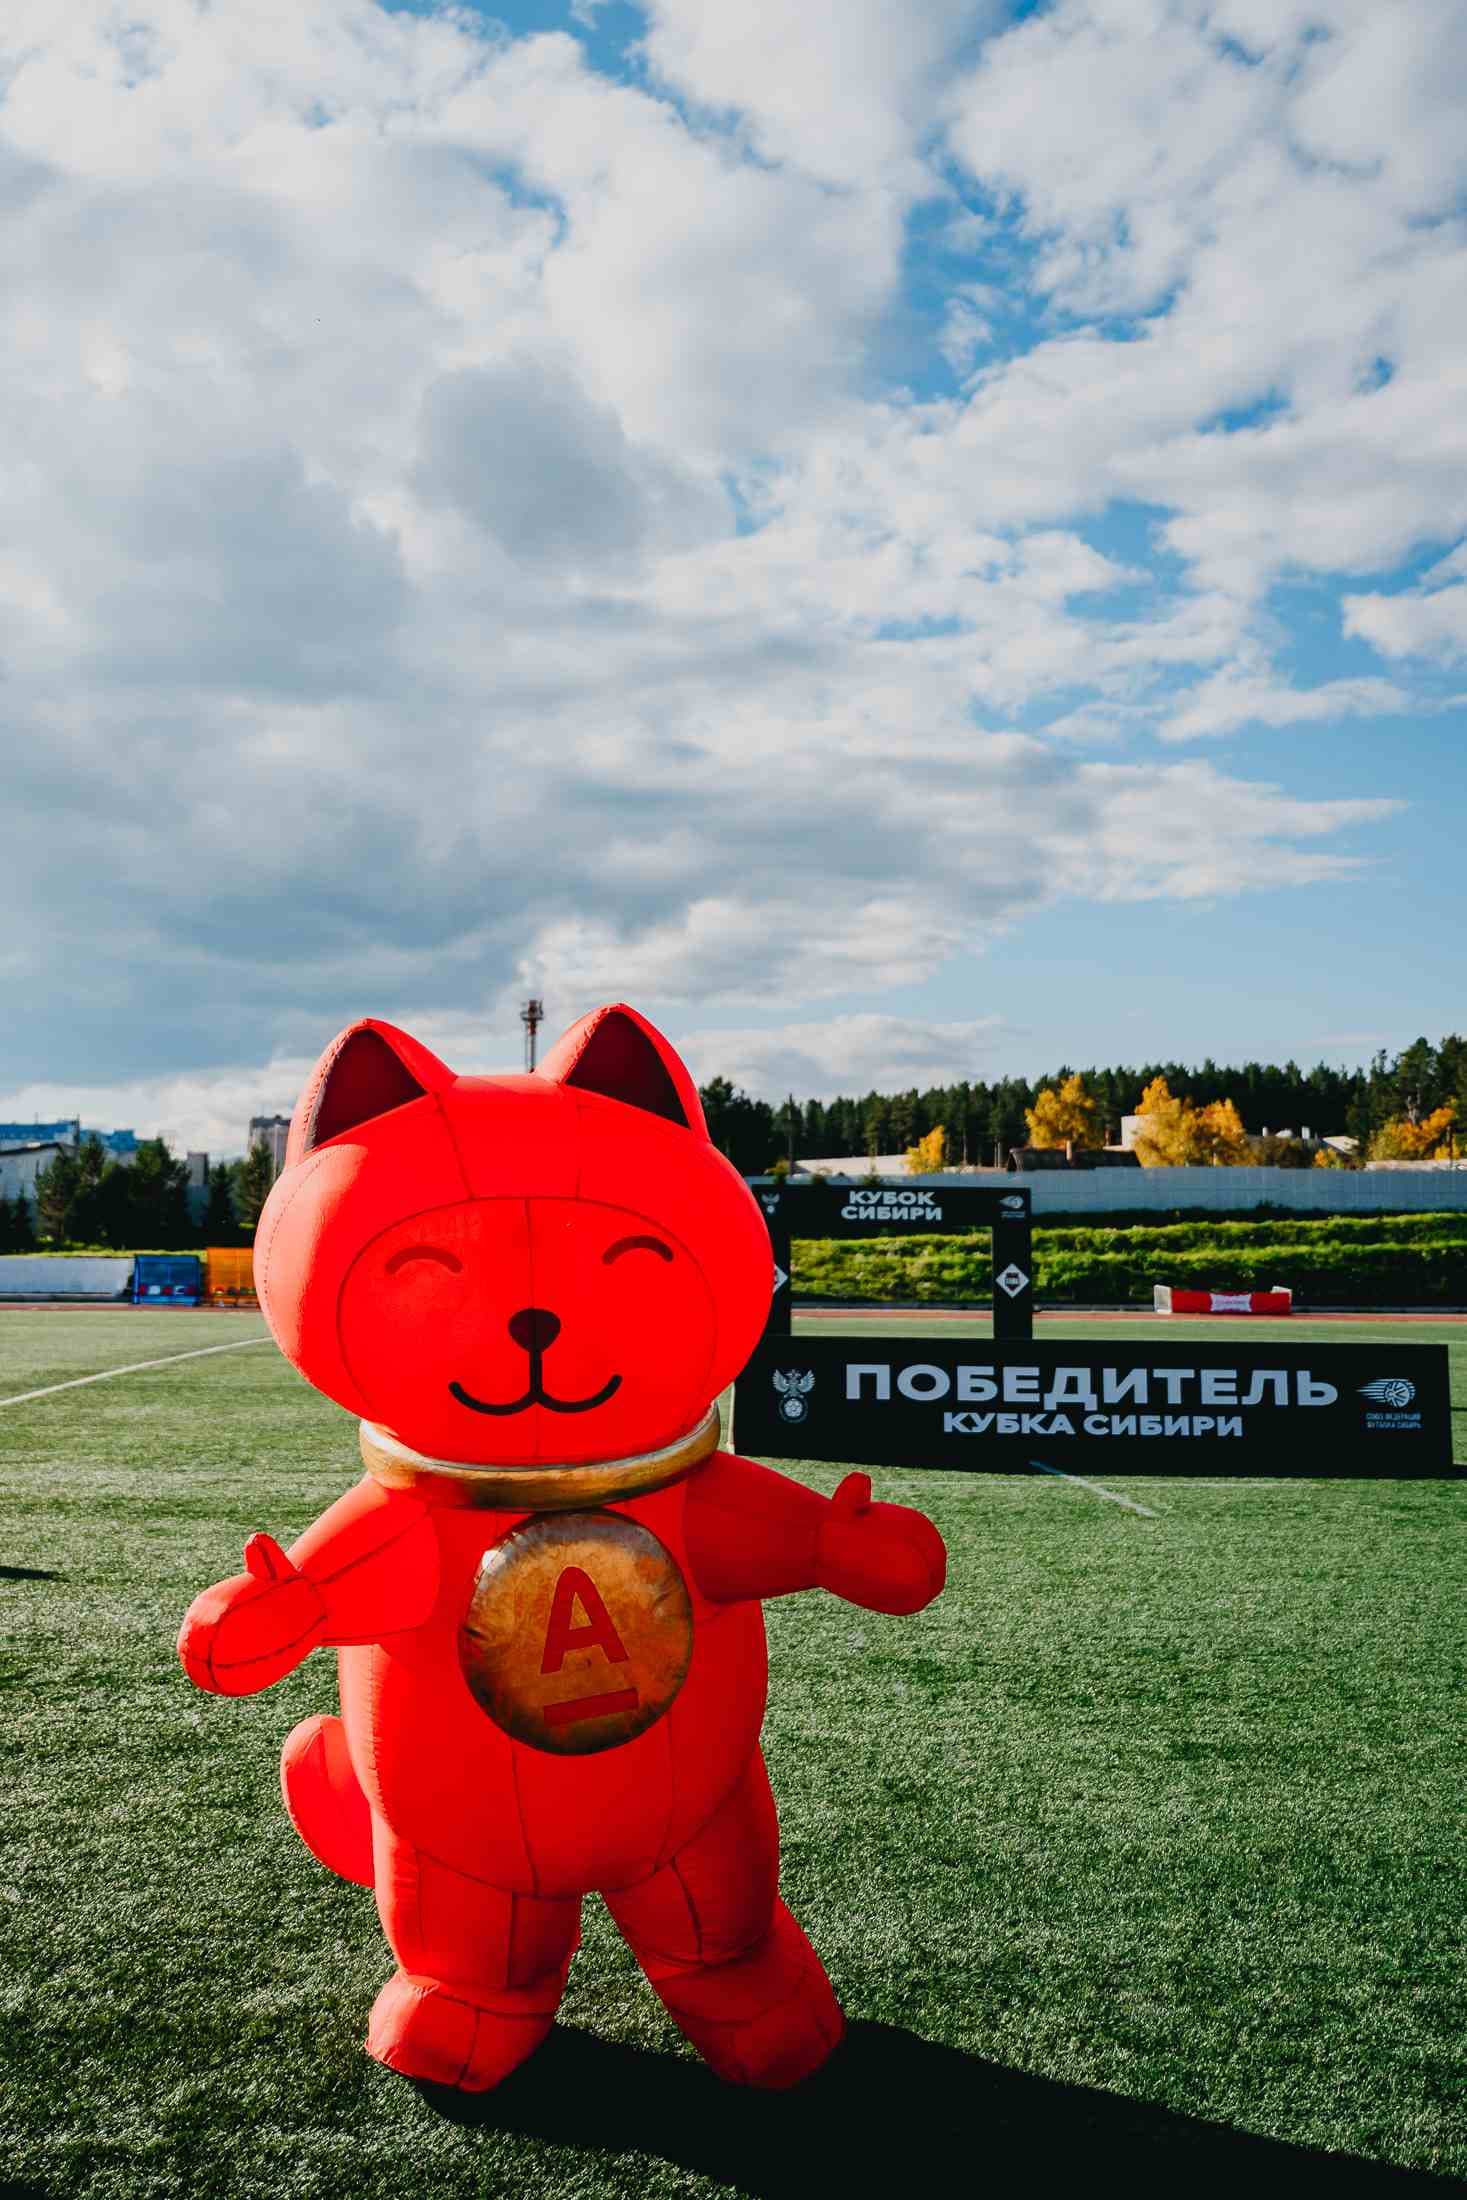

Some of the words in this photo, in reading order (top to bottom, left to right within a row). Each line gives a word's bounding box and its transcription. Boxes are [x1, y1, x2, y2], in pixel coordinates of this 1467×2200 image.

[849, 1191, 936, 1206] КУБОК
[840, 1206, 943, 1221] СИБИРИ
[845, 1363, 1339, 1412] ПОБЕДИТЕЛЬ
[943, 1411, 1077, 1435] КУБКА
[1083, 1413, 1243, 1437] СИБИРИ
